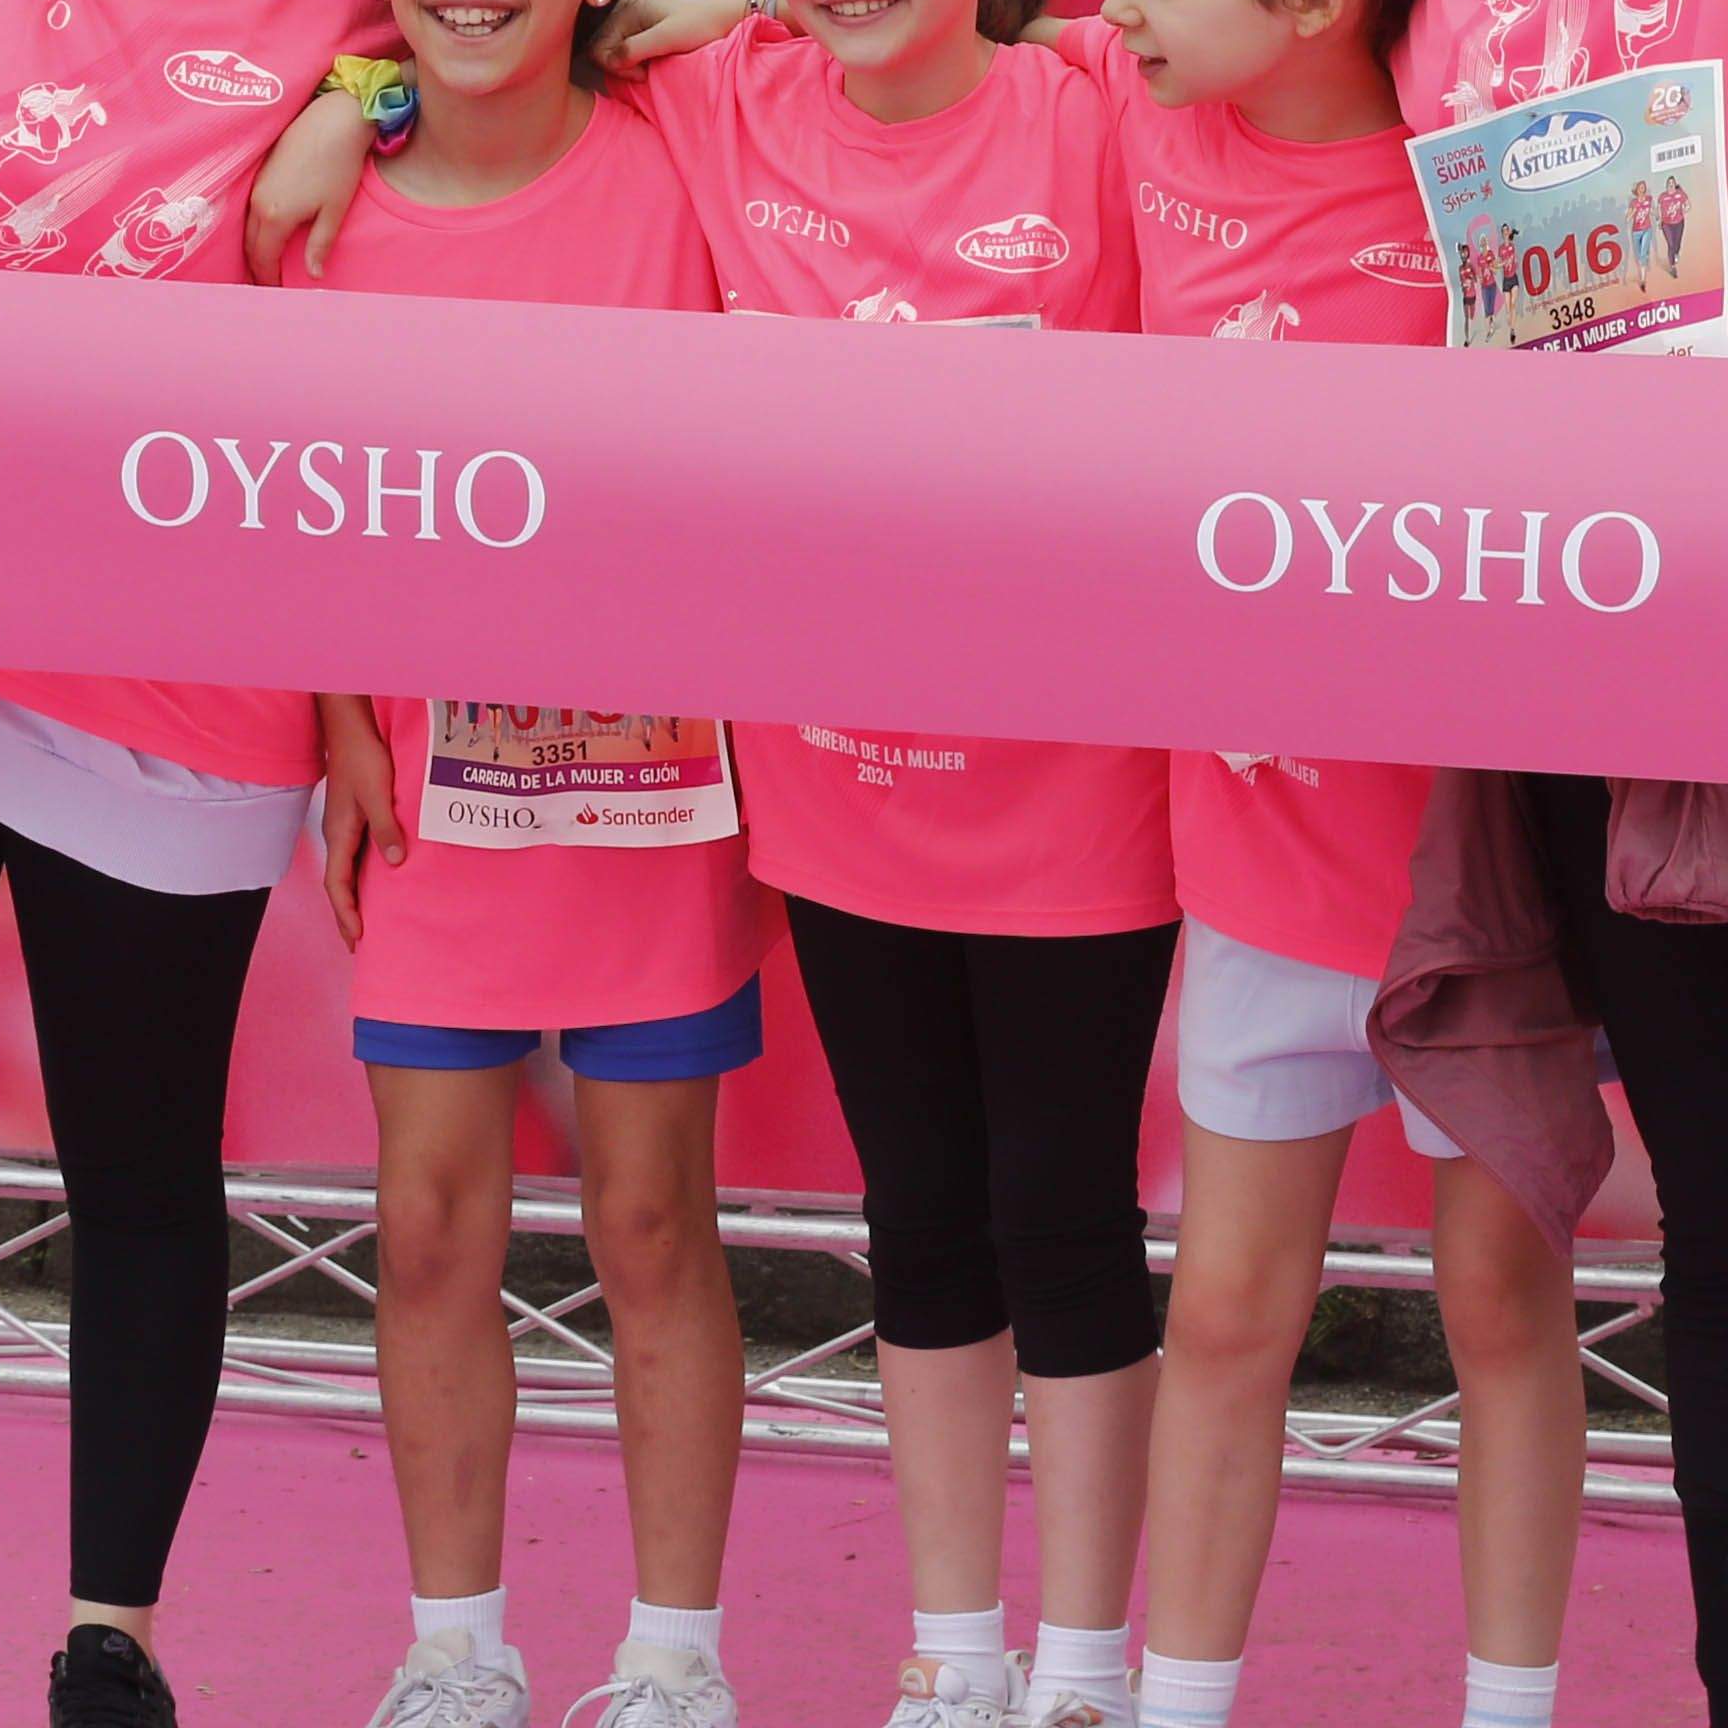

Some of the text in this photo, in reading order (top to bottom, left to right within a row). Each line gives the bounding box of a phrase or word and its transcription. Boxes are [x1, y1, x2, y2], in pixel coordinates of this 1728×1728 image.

[172, 60, 273, 100] ASTURIANA
[1432, 143, 1485, 167] TU DORSAL
[1437, 154, 1488, 185] SUMA
[1508, 135, 1614, 183] ASTURIANA
[745, 200, 850, 248] OYSHO
[1139, 181, 1248, 250] OYSHO
[965, 237, 1061, 260] ASTURIANA
[1358, 250, 1442, 273] ASTURIA
[1522, 223, 1622, 297] 016
[1549, 296, 1596, 331] 3348
[1564, 332, 1582, 352] LA
[1582, 319, 1628, 347] MUJER
[1637, 301, 1682, 329] GIJÓN
[121, 431, 546, 548] OYSHO
[1196, 491, 1661, 613] OYSHO
[531, 739, 589, 766] 3351
[860, 740, 881, 762] DE
[883, 745, 904, 767] LA
[906, 748, 966, 771] MUJER
[462, 761, 681, 790] CARRERA DE LA MUJER GIJÓN
[856, 762, 894, 788] 2024
[1278, 754, 1319, 789] MUJER
[447, 800, 696, 830] OYSHO Santander
